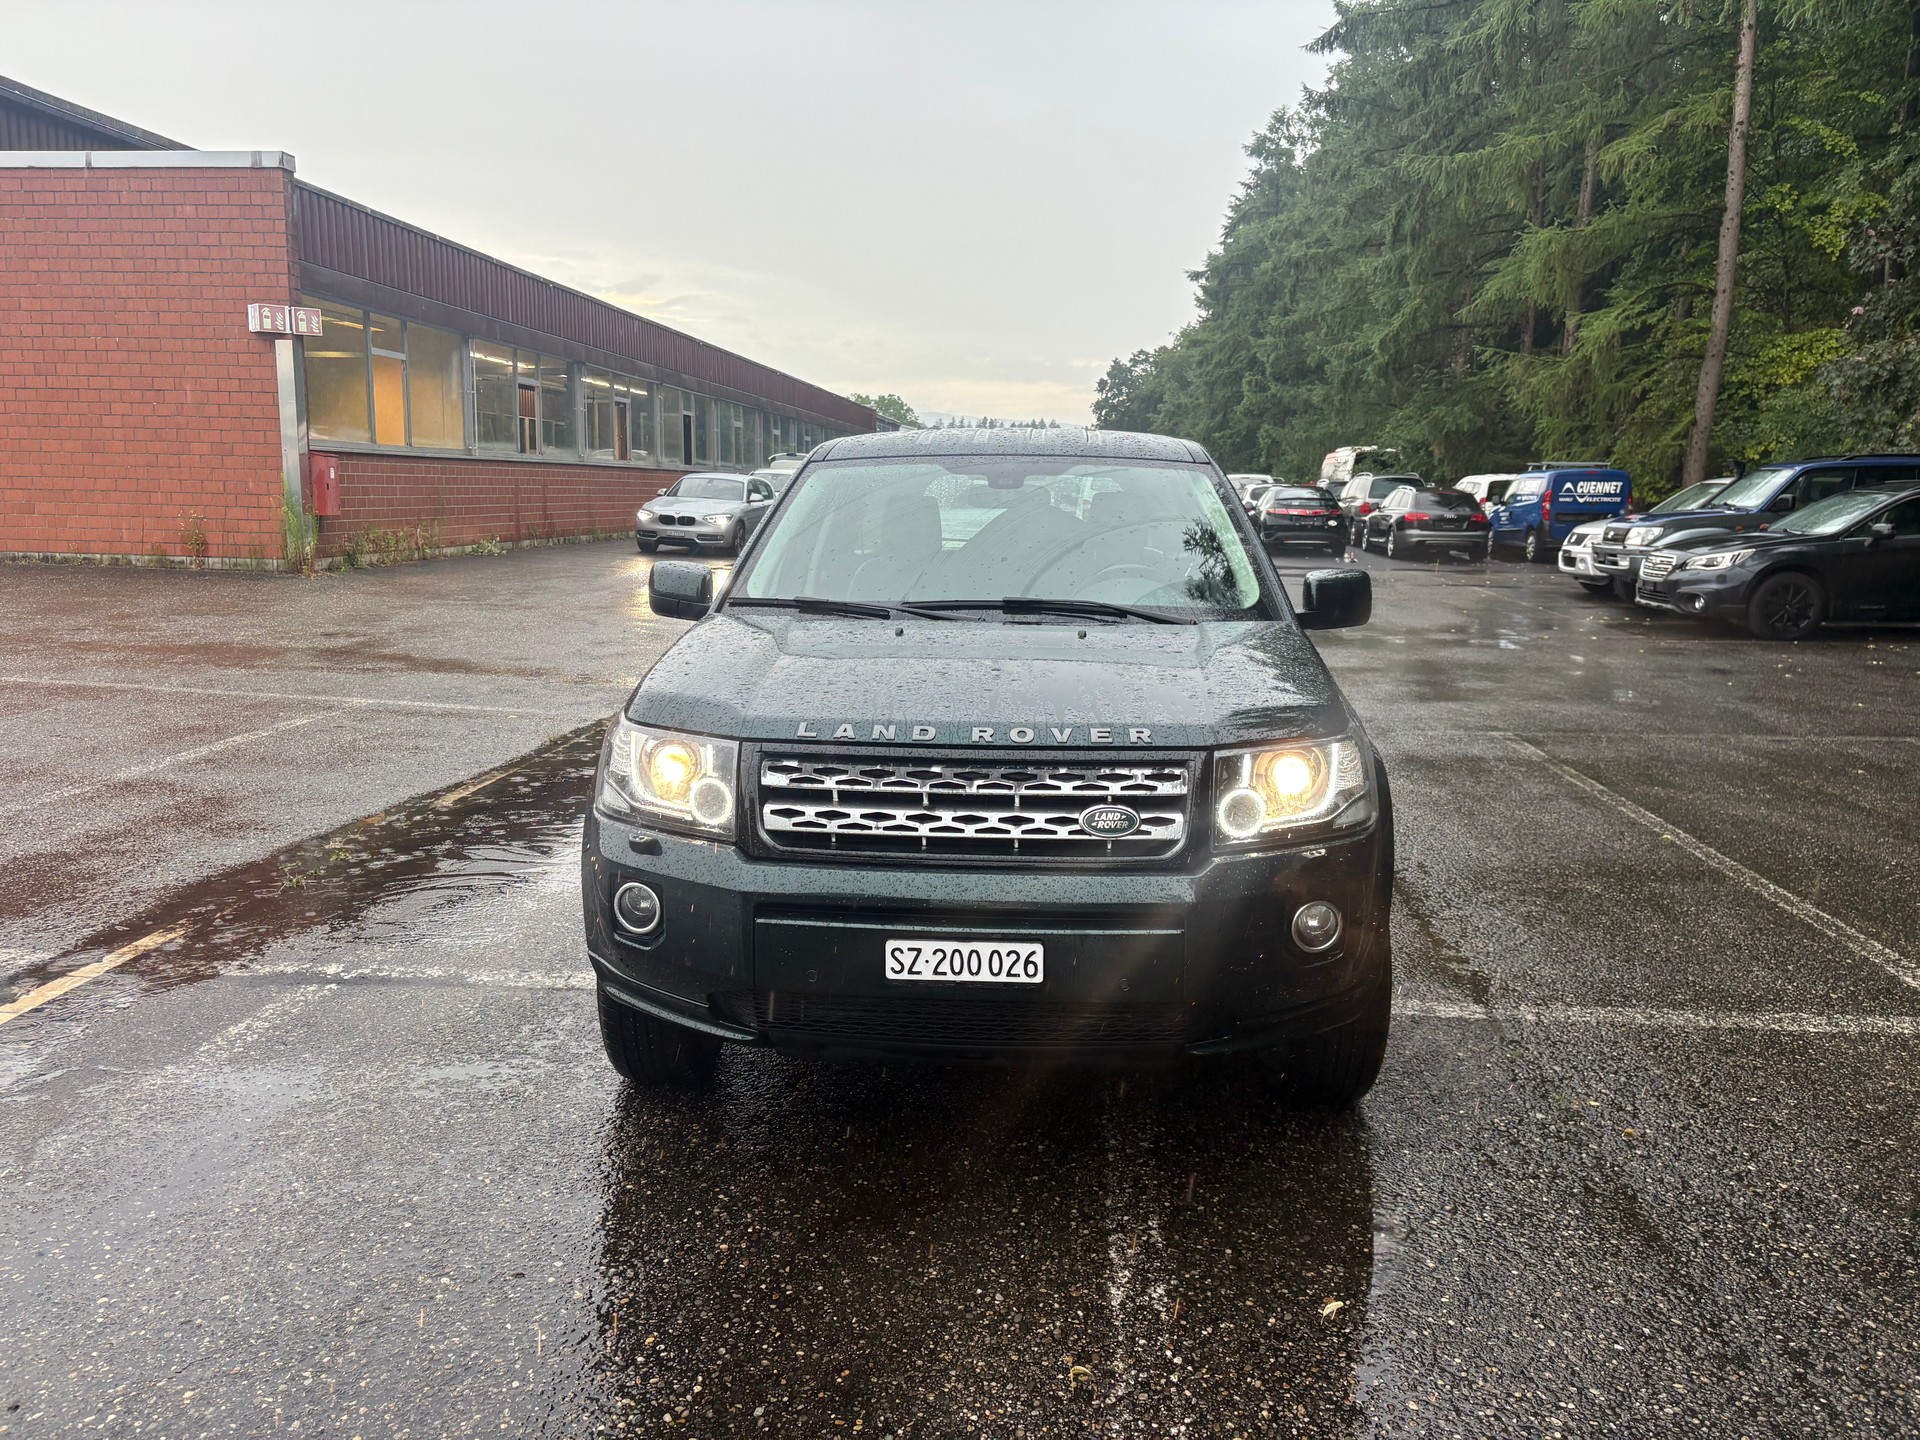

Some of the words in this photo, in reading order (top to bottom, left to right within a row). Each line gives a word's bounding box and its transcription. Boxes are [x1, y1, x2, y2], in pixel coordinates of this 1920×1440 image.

[797, 722, 936, 741] LAND
[971, 727, 1152, 744] ROVER
[1094, 812, 1121, 821] LAND
[1097, 820, 1129, 829] ROVER
